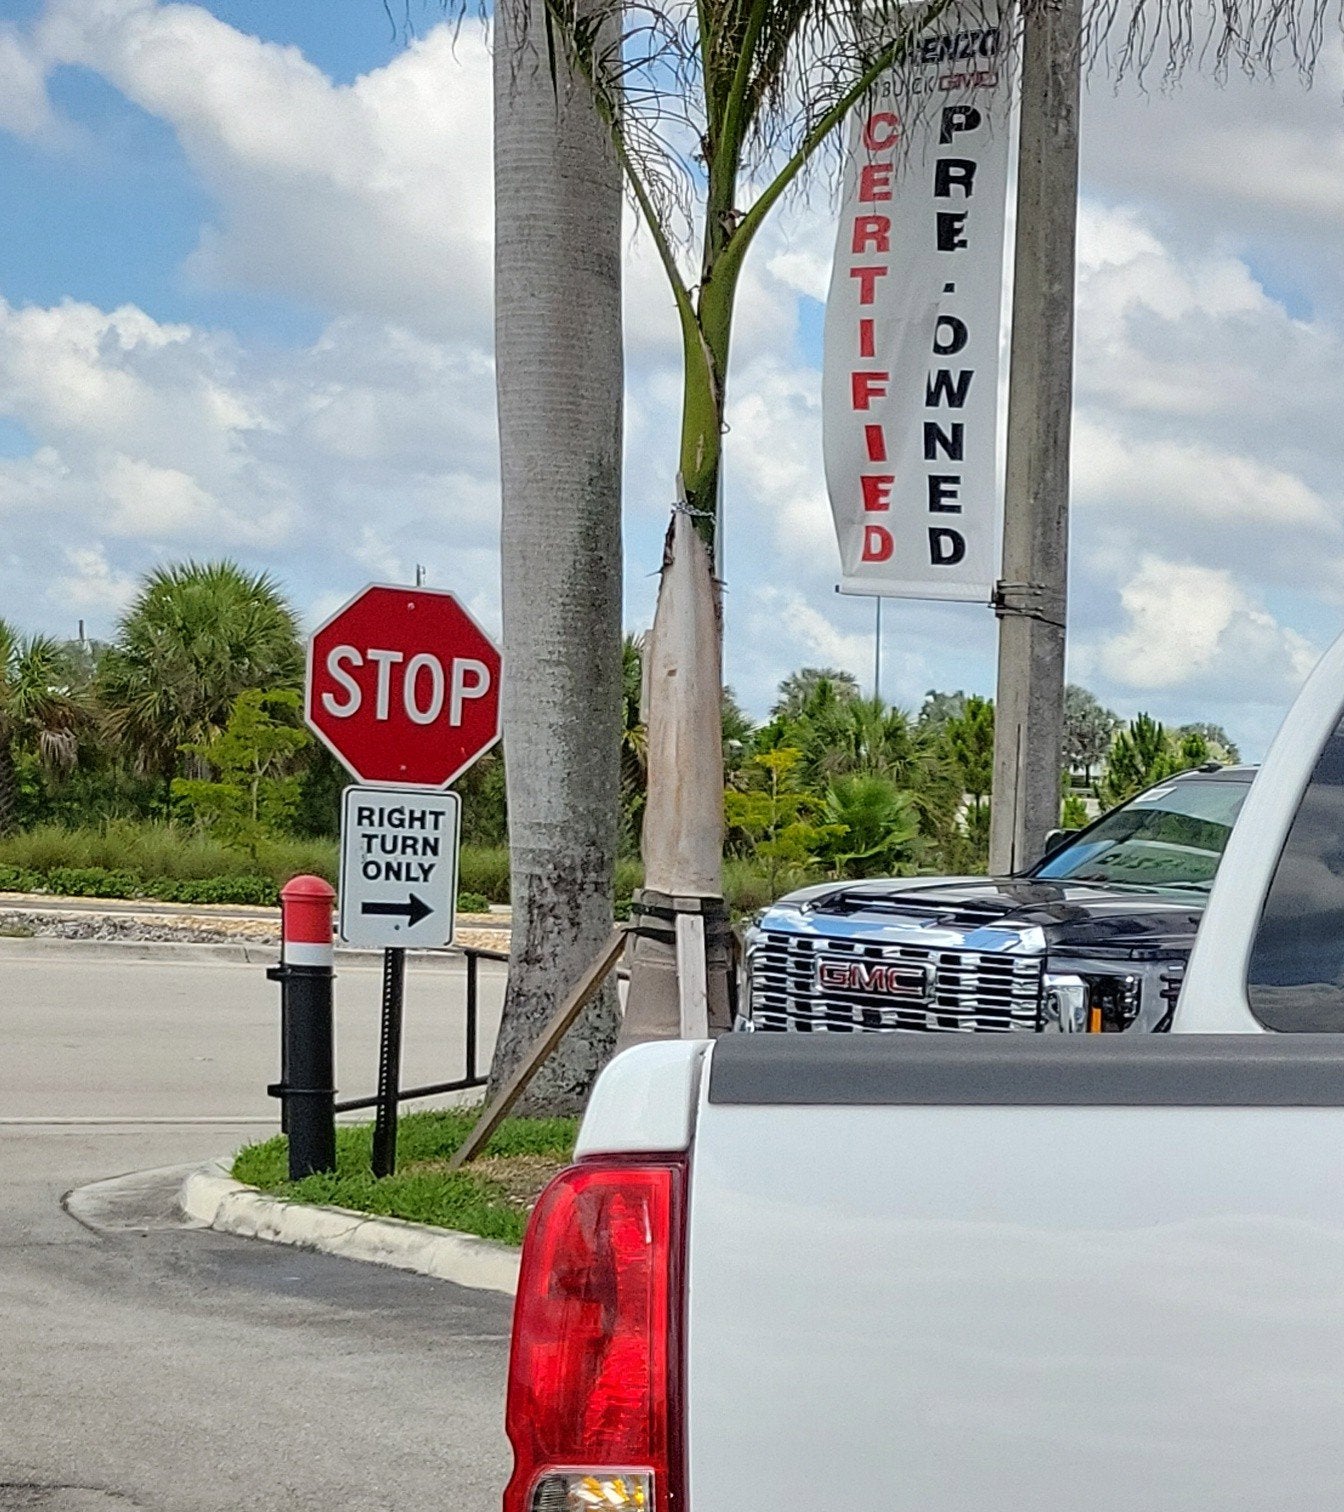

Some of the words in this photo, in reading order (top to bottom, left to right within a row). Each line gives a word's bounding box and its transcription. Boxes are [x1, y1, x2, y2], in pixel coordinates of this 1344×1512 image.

[850, 112, 899, 562] CERTIFIED
[321, 645, 491, 727] STOP
[357, 806, 446, 831] RIGHT
[362, 834, 440, 857] TURN
[362, 859, 437, 883] ONLY
[820, 961, 927, 996] GMC
